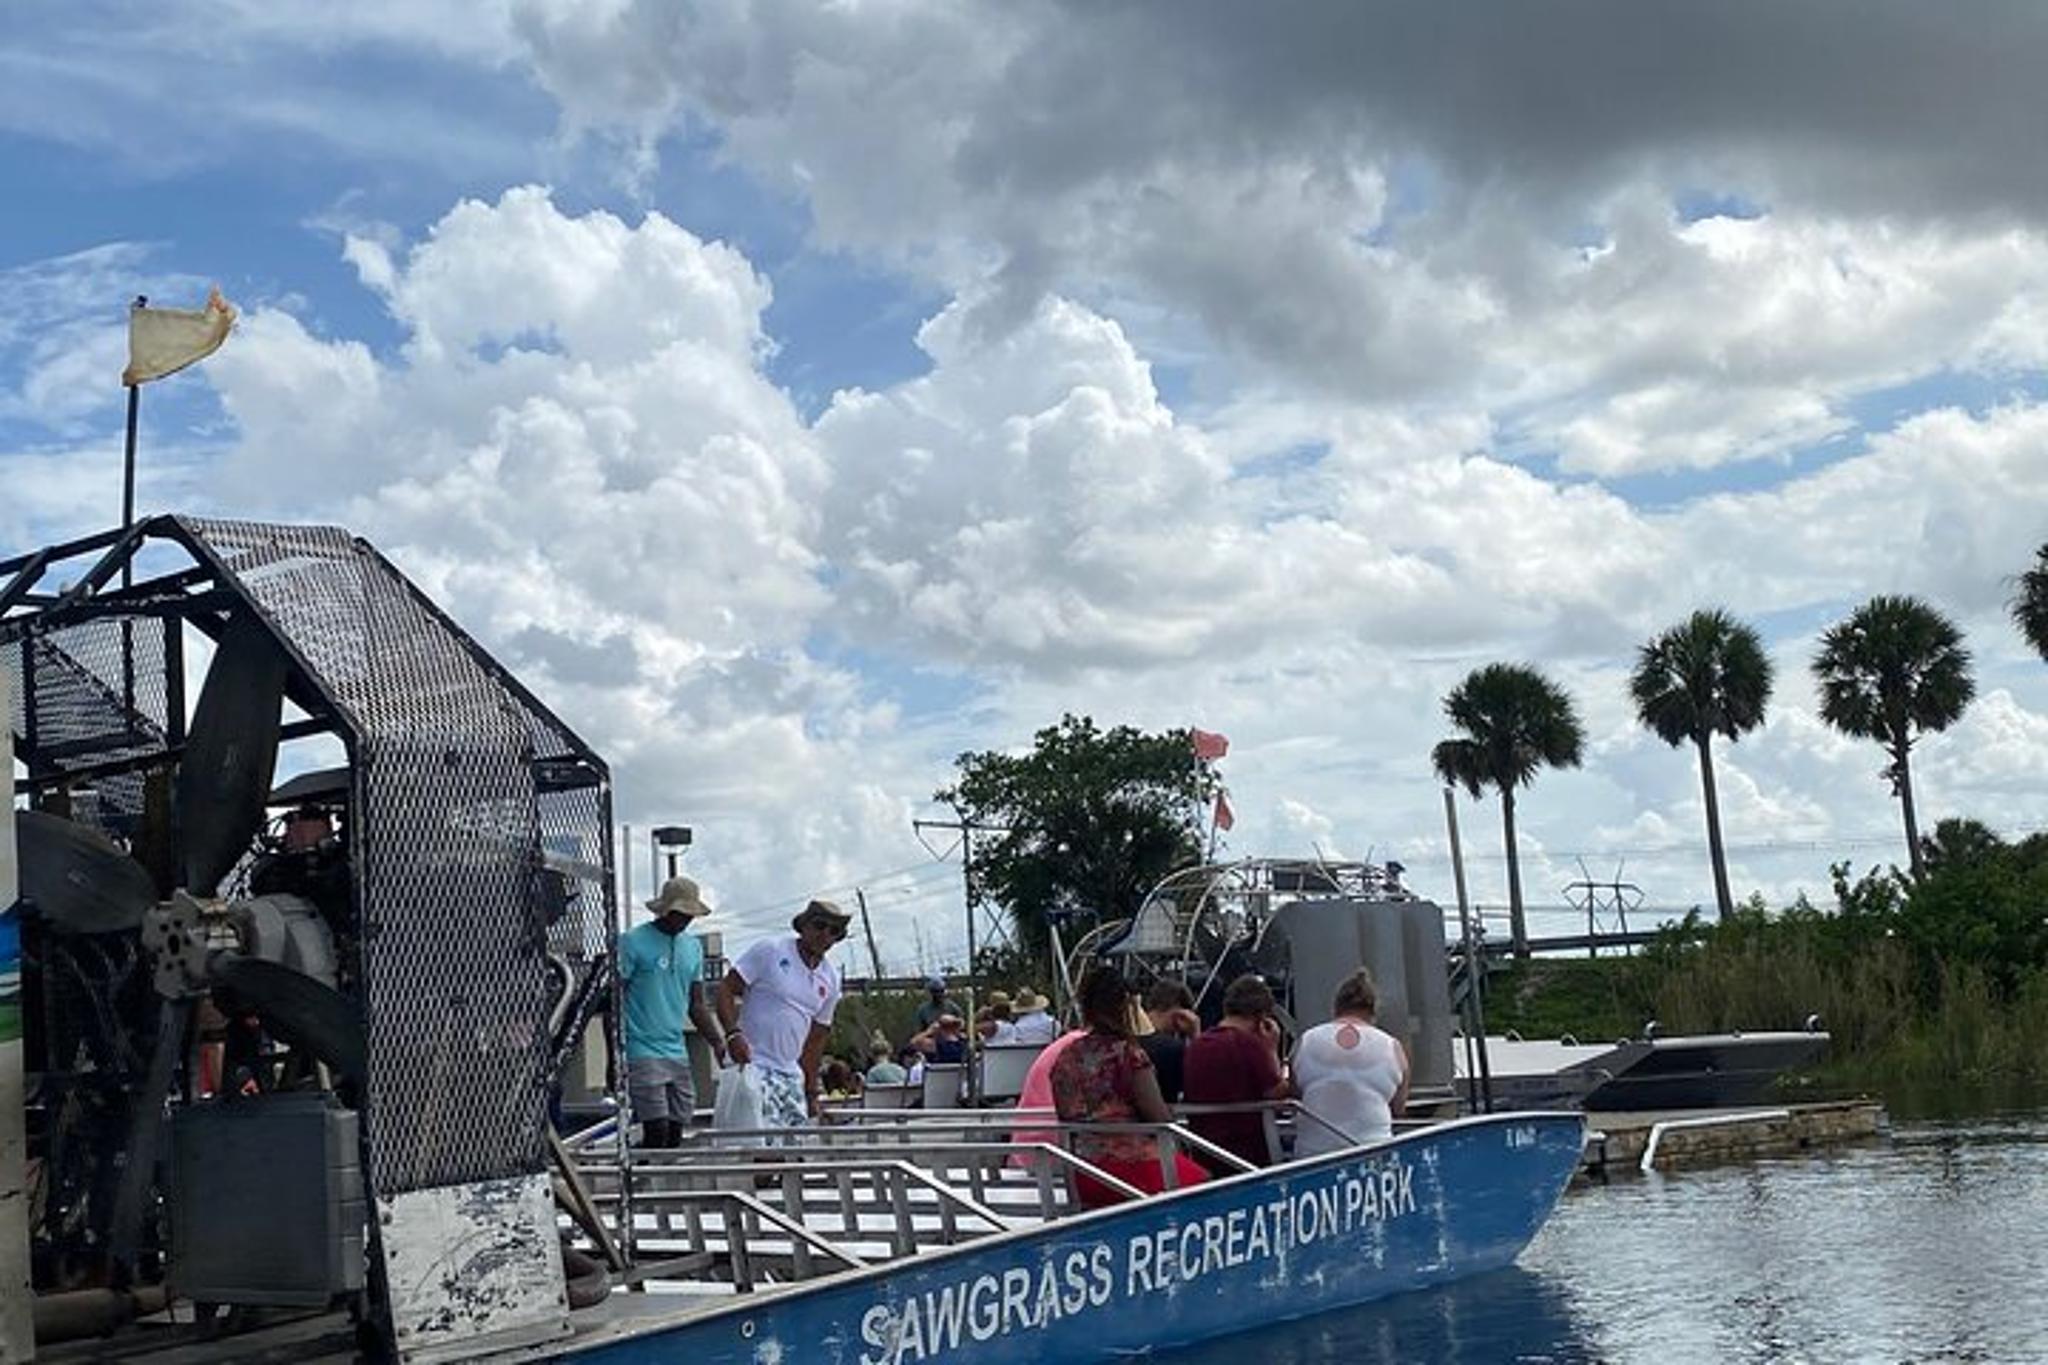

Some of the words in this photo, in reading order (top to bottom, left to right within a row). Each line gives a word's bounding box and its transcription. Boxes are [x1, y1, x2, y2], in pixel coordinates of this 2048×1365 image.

[860, 1244, 1112, 1365] SAWGRASS
[1127, 1185, 1339, 1296] RECREATION
[1345, 1165, 1416, 1232] PARK
